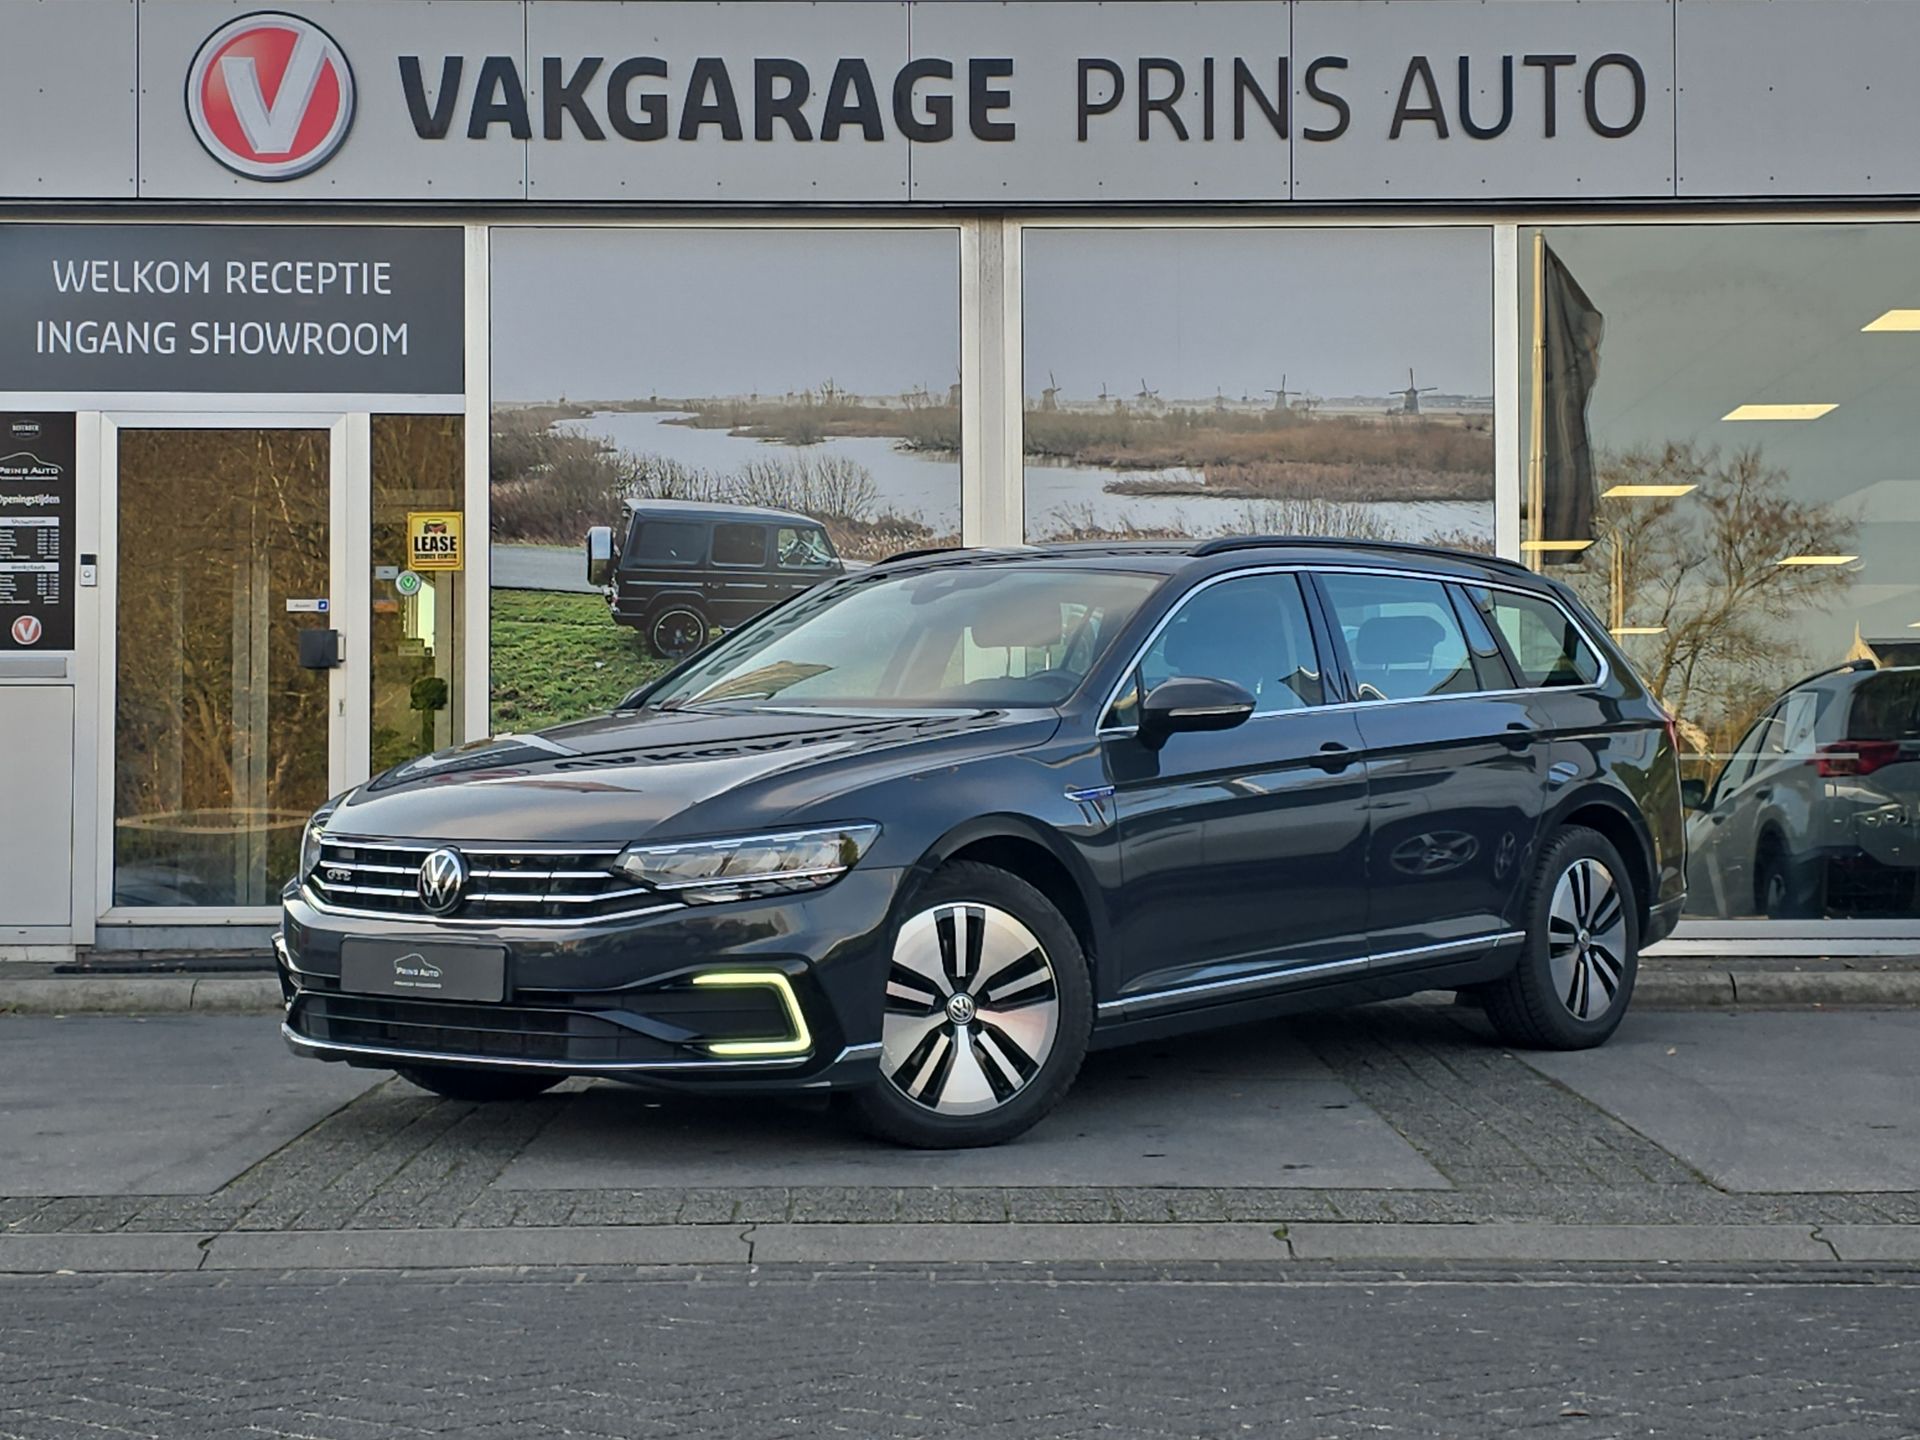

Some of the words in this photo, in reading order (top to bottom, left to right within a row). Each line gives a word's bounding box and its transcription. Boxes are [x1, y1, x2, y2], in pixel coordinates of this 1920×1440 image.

[398, 56, 1016, 142] VAKGARAGE
[1078, 56, 1350, 141] PRINS
[1388, 53, 1646, 139] AUTO
[53, 260, 210, 294] WELKOM
[226, 261, 392, 295] RECEPTIE
[37, 321, 176, 354] INGANG
[189, 322, 408, 355] SHOWROOM
[30, 467, 59, 475] AUTO
[413, 536, 457, 552] LEASE
[326, 868, 352, 881] GTE
